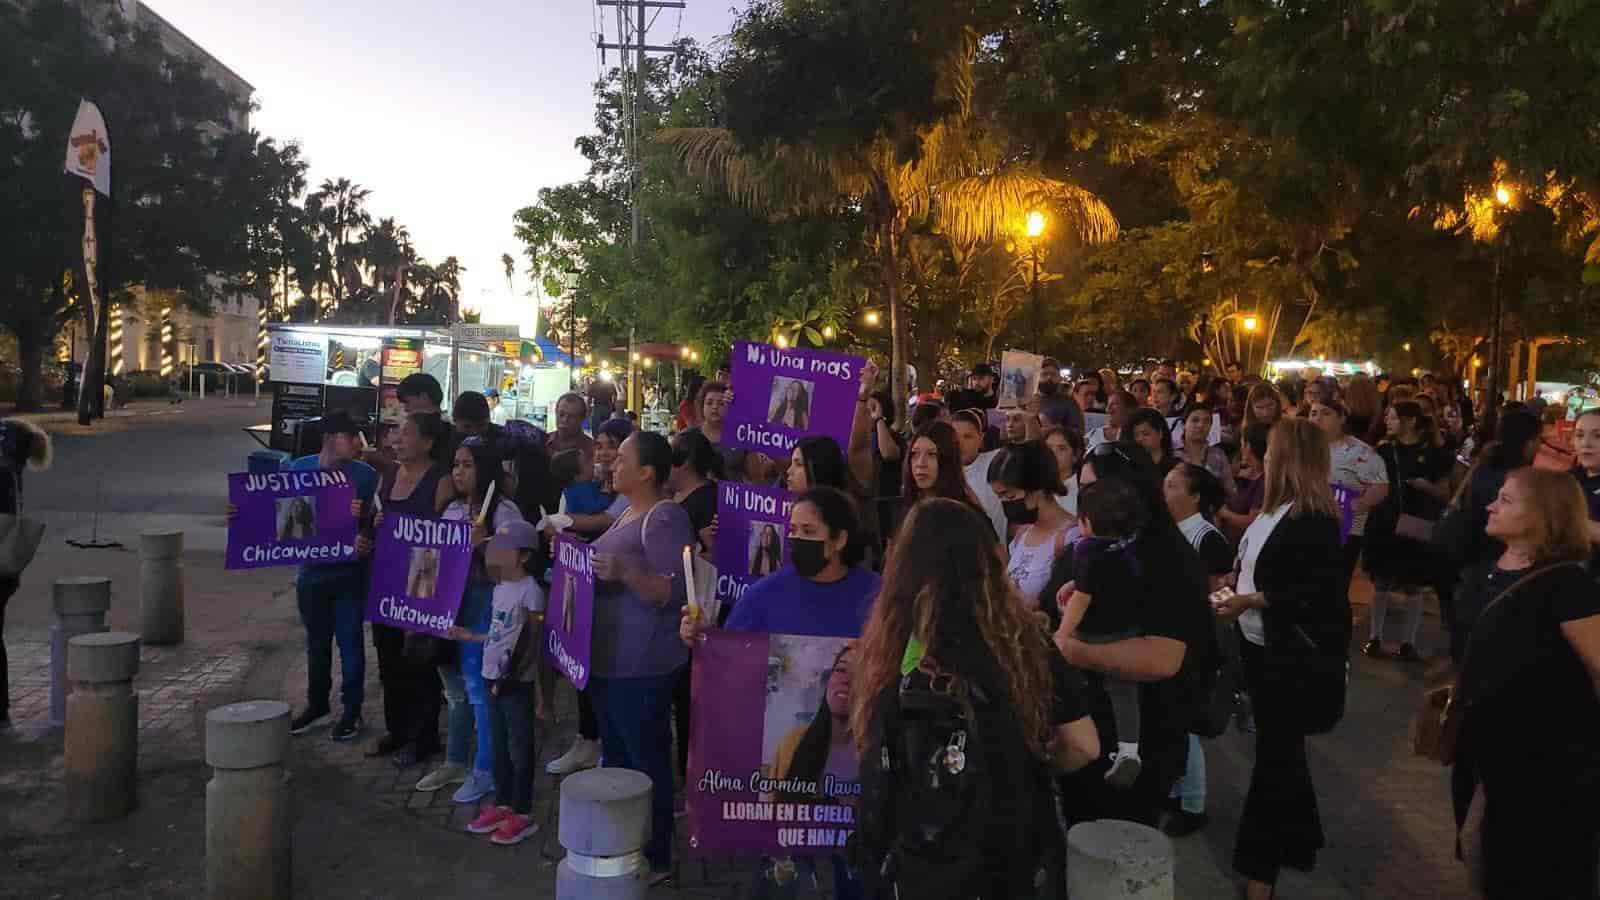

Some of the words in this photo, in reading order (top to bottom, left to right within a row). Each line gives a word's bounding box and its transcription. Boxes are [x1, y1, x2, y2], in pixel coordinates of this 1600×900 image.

[747, 344, 766, 365] Ni
[771, 350, 804, 370] Una
[811, 359, 850, 380] mas
[245, 471, 349, 492] JUSTICIA!!
[725, 486, 740, 510] Ni
[744, 490, 776, 515] Una
[393, 516, 472, 552] JUSTICIA!!
[242, 541, 341, 562] Chicaweed
[698, 769, 744, 794] Alma
[750, 772, 817, 794] Carmina
[723, 801, 773, 821] LLORAN
[776, 803, 794, 821] EN
[797, 804, 811, 822] EL
[777, 829, 805, 847] QUE
[807, 829, 836, 847] HAN
[837, 829, 856, 847] A
